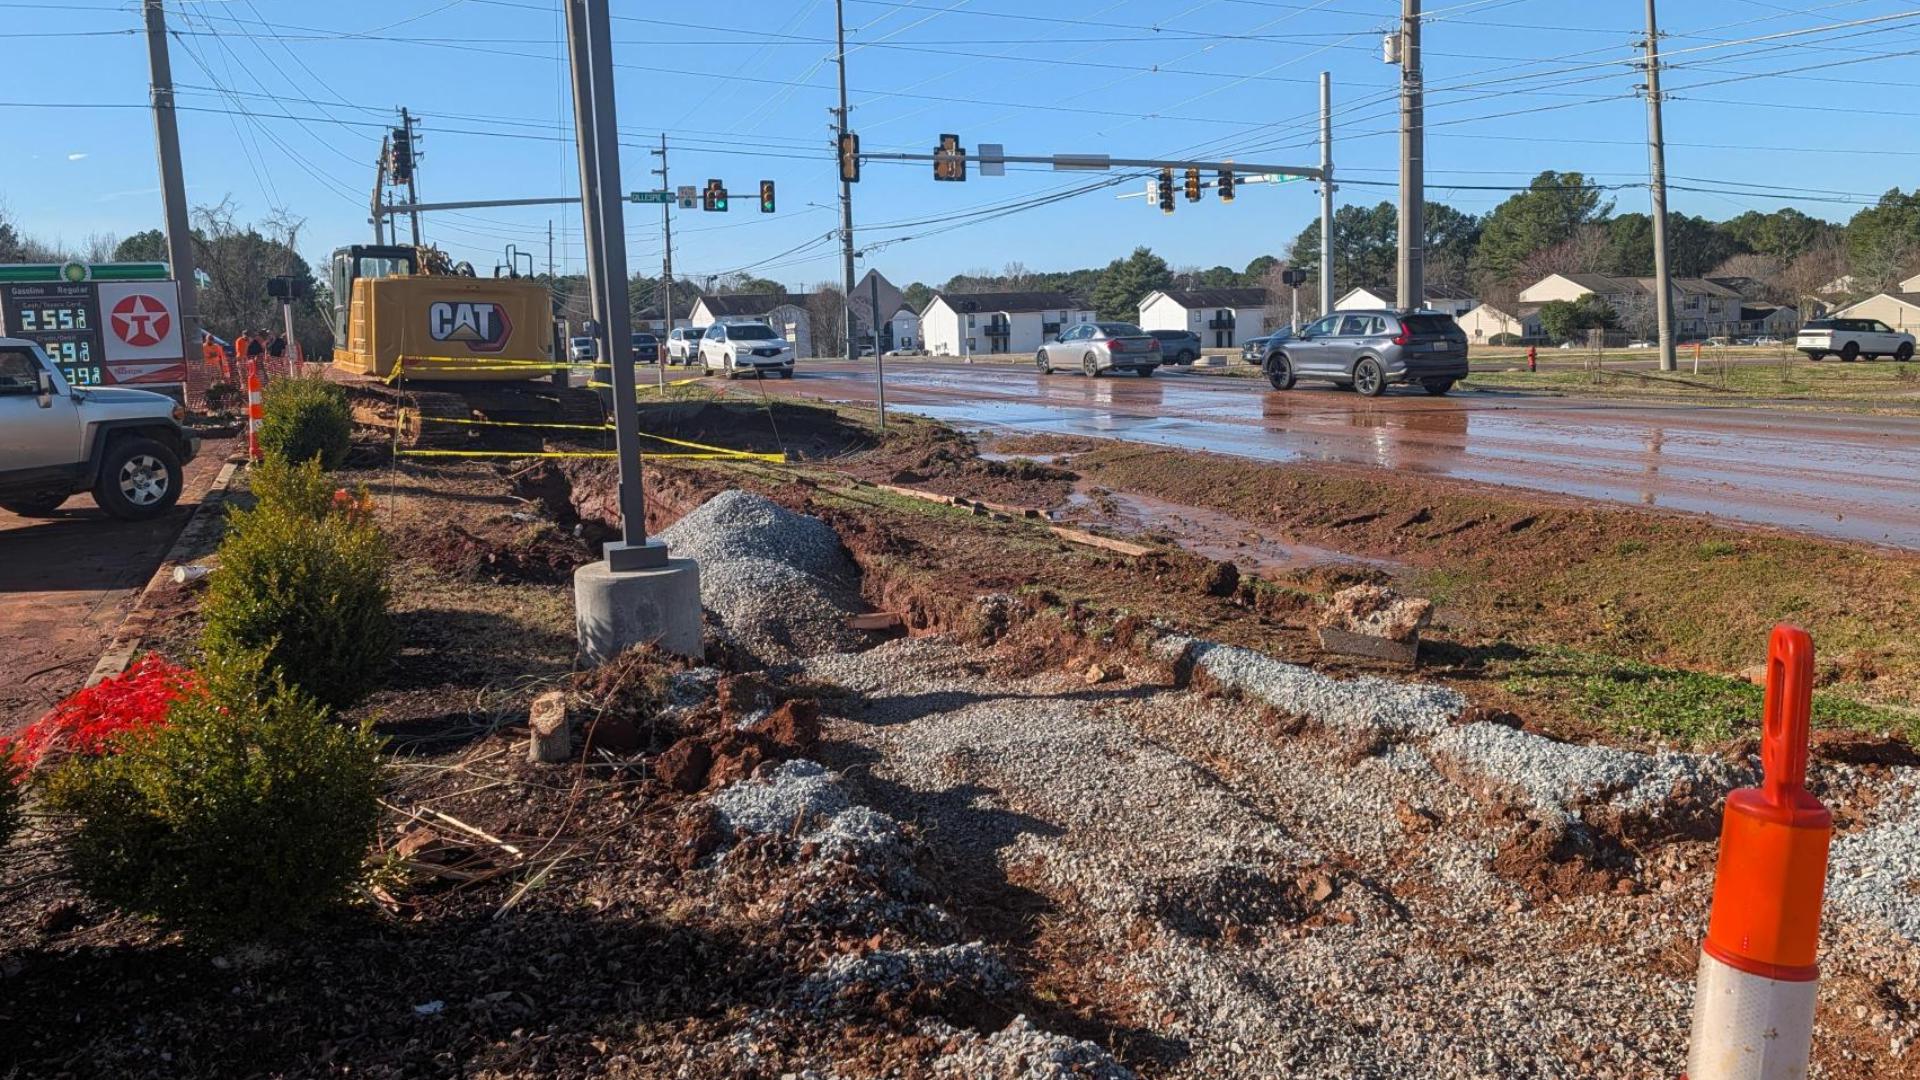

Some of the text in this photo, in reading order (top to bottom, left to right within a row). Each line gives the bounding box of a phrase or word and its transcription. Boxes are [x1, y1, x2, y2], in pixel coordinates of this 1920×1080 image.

[11, 285, 89, 295] Gasoline Regular
[431, 302, 494, 340] CAT
